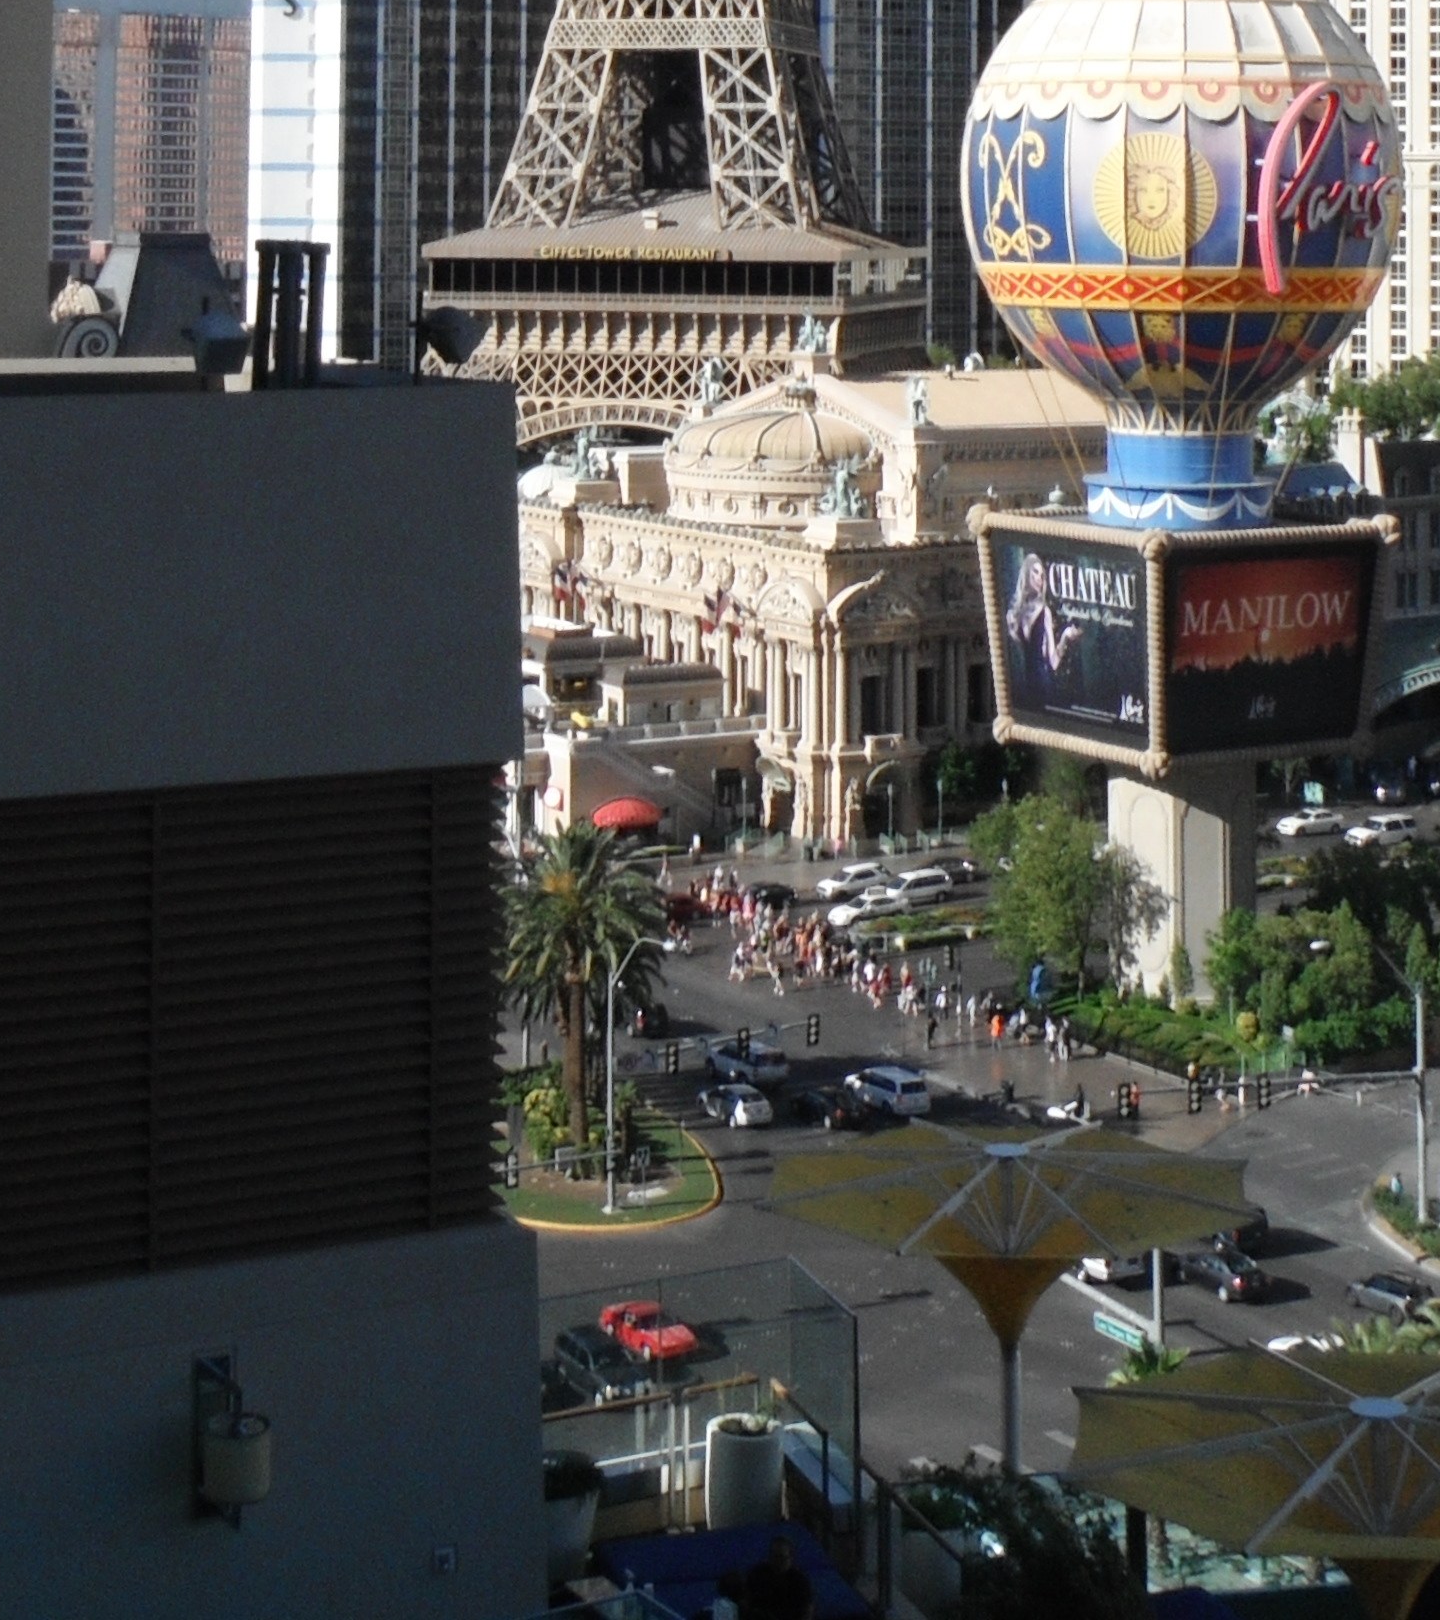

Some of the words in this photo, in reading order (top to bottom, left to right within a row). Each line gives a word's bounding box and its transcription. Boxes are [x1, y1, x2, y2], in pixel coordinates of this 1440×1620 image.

[1257, 80, 1402, 296] Paris
[539, 245, 582, 260] EIFFEL
[586, 246, 633, 260] TOWER
[637, 246, 717, 261] RESTAURANT
[1049, 562, 1137, 610] CHATEAU
[1182, 590, 1352, 636] MANILOW
